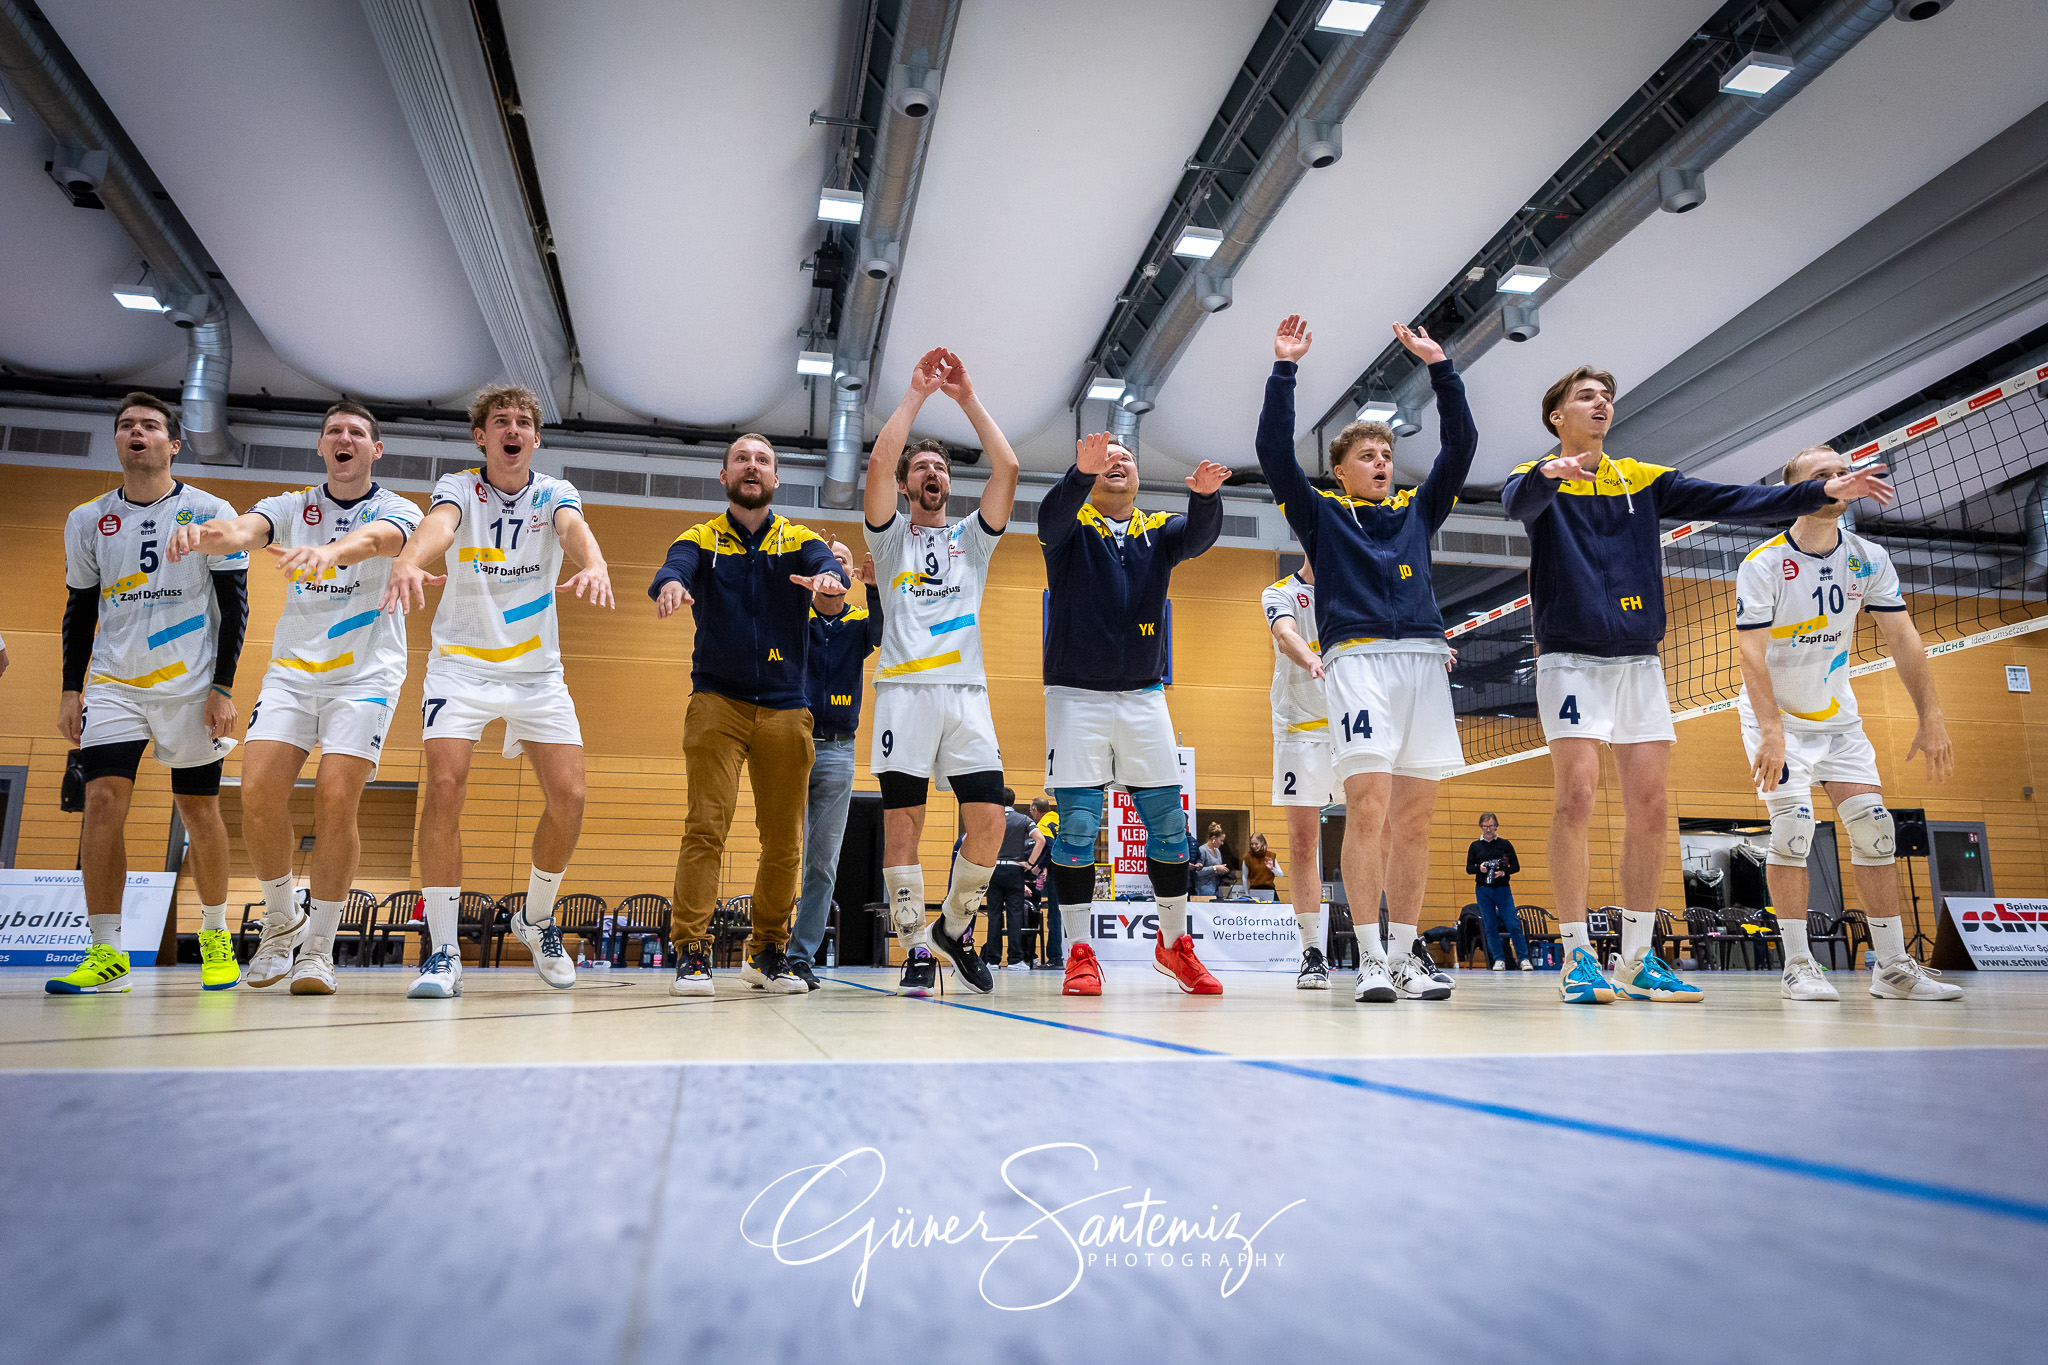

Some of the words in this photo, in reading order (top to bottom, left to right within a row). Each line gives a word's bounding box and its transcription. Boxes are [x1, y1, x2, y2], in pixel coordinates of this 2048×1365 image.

[490, 518, 523, 549] 17
[140, 540, 159, 573] 5
[501, 563, 540, 576] Daigfuss
[925, 552, 939, 576] 9
[305, 582, 329, 593] Zapf
[120, 589, 142, 602] Zapf
[1812, 584, 1844, 615] 10
[1620, 596, 1642, 611] FH
[1139, 623, 1155, 636] YK
[1799, 634, 1821, 644] Zapf
[1932, 641, 1965, 655] FUCHS
[1971, 634, 1991, 645] Ideen
[1993, 624, 2029, 640] umsetzen
[768, 649, 783, 661] AL
[831, 695, 851, 705] MM
[1709, 701, 1731, 712] FUCHS
[1559, 695, 1581, 724] 4
[1341, 710, 1373, 742] 14
[882, 729, 894, 758] 9
[1048, 749, 1055, 776] 1
[1284, 772, 1296, 795] 2
[1127, 845, 1147, 857] FAH
[0, 911, 90, 930] yballis
[1213, 915, 1297, 927] Großformatdr
[1213, 930, 1297, 941] Werbetechnik
[1970, 944, 1983, 952] Ihr
[1984, 944, 2023, 953] Spezialist
[2025, 944, 2036, 952] für
